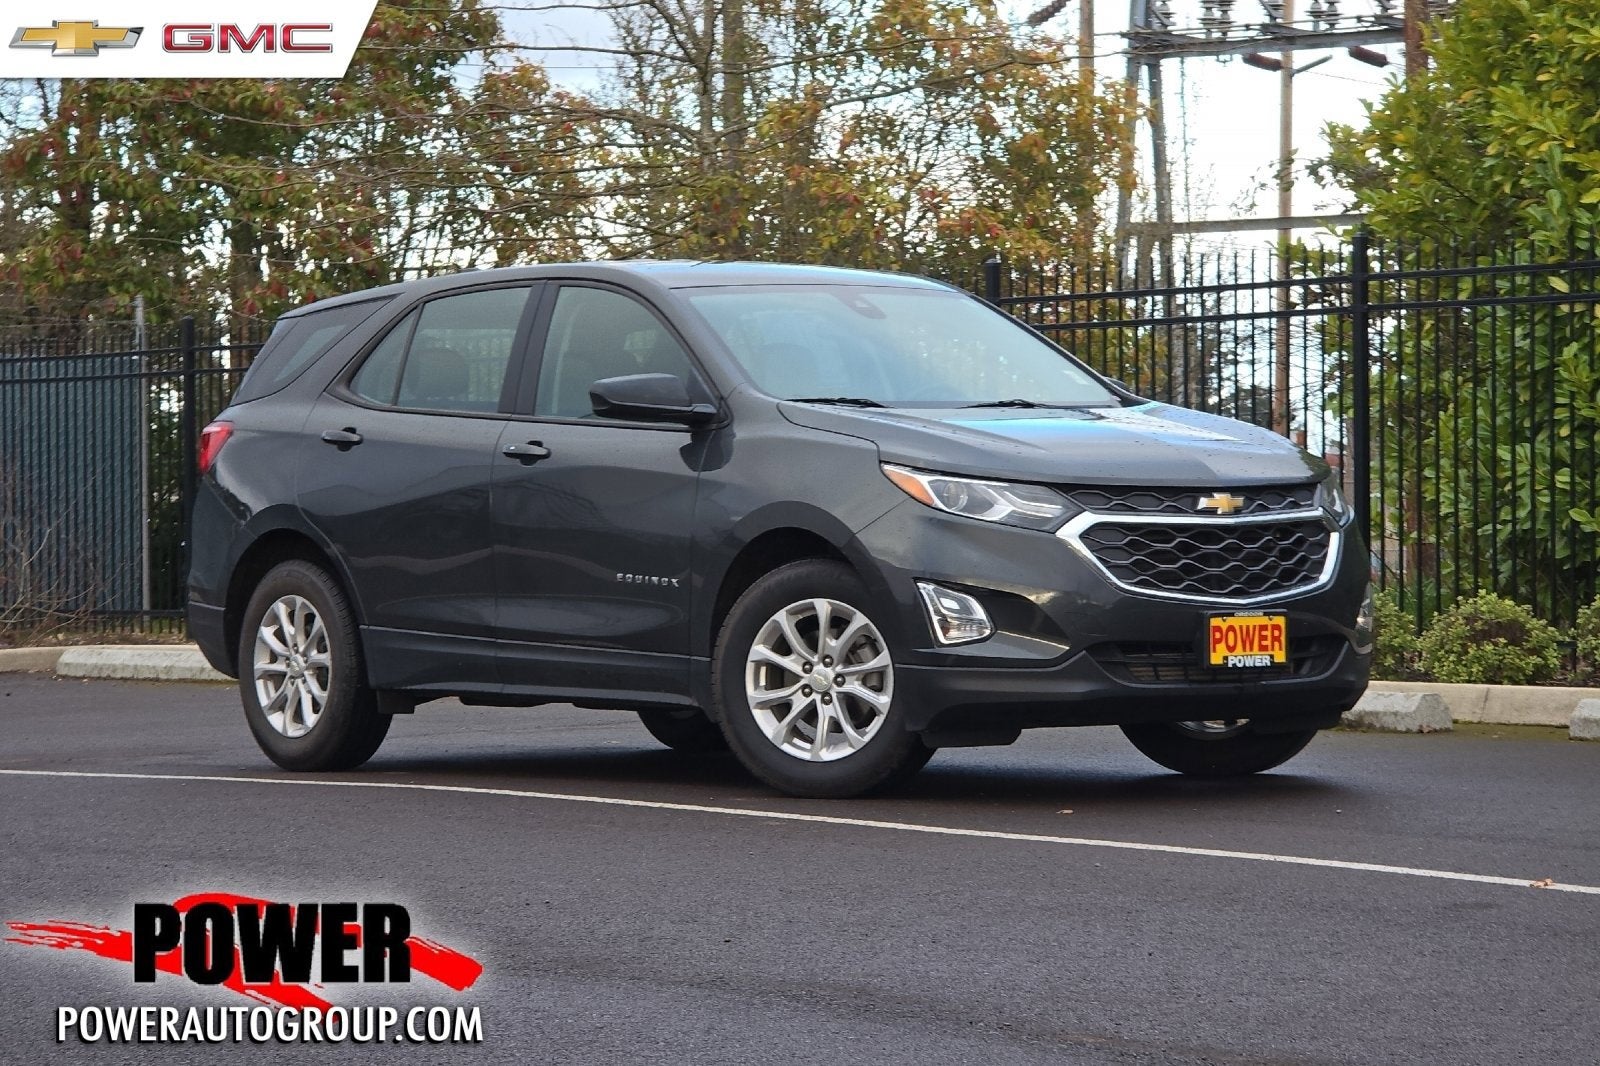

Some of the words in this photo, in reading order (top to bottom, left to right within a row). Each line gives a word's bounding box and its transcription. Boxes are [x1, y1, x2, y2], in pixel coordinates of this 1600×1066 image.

[616, 573, 680, 587] EQUINOX
[1211, 624, 1283, 653] POWER
[1227, 655, 1271, 667] POWER
